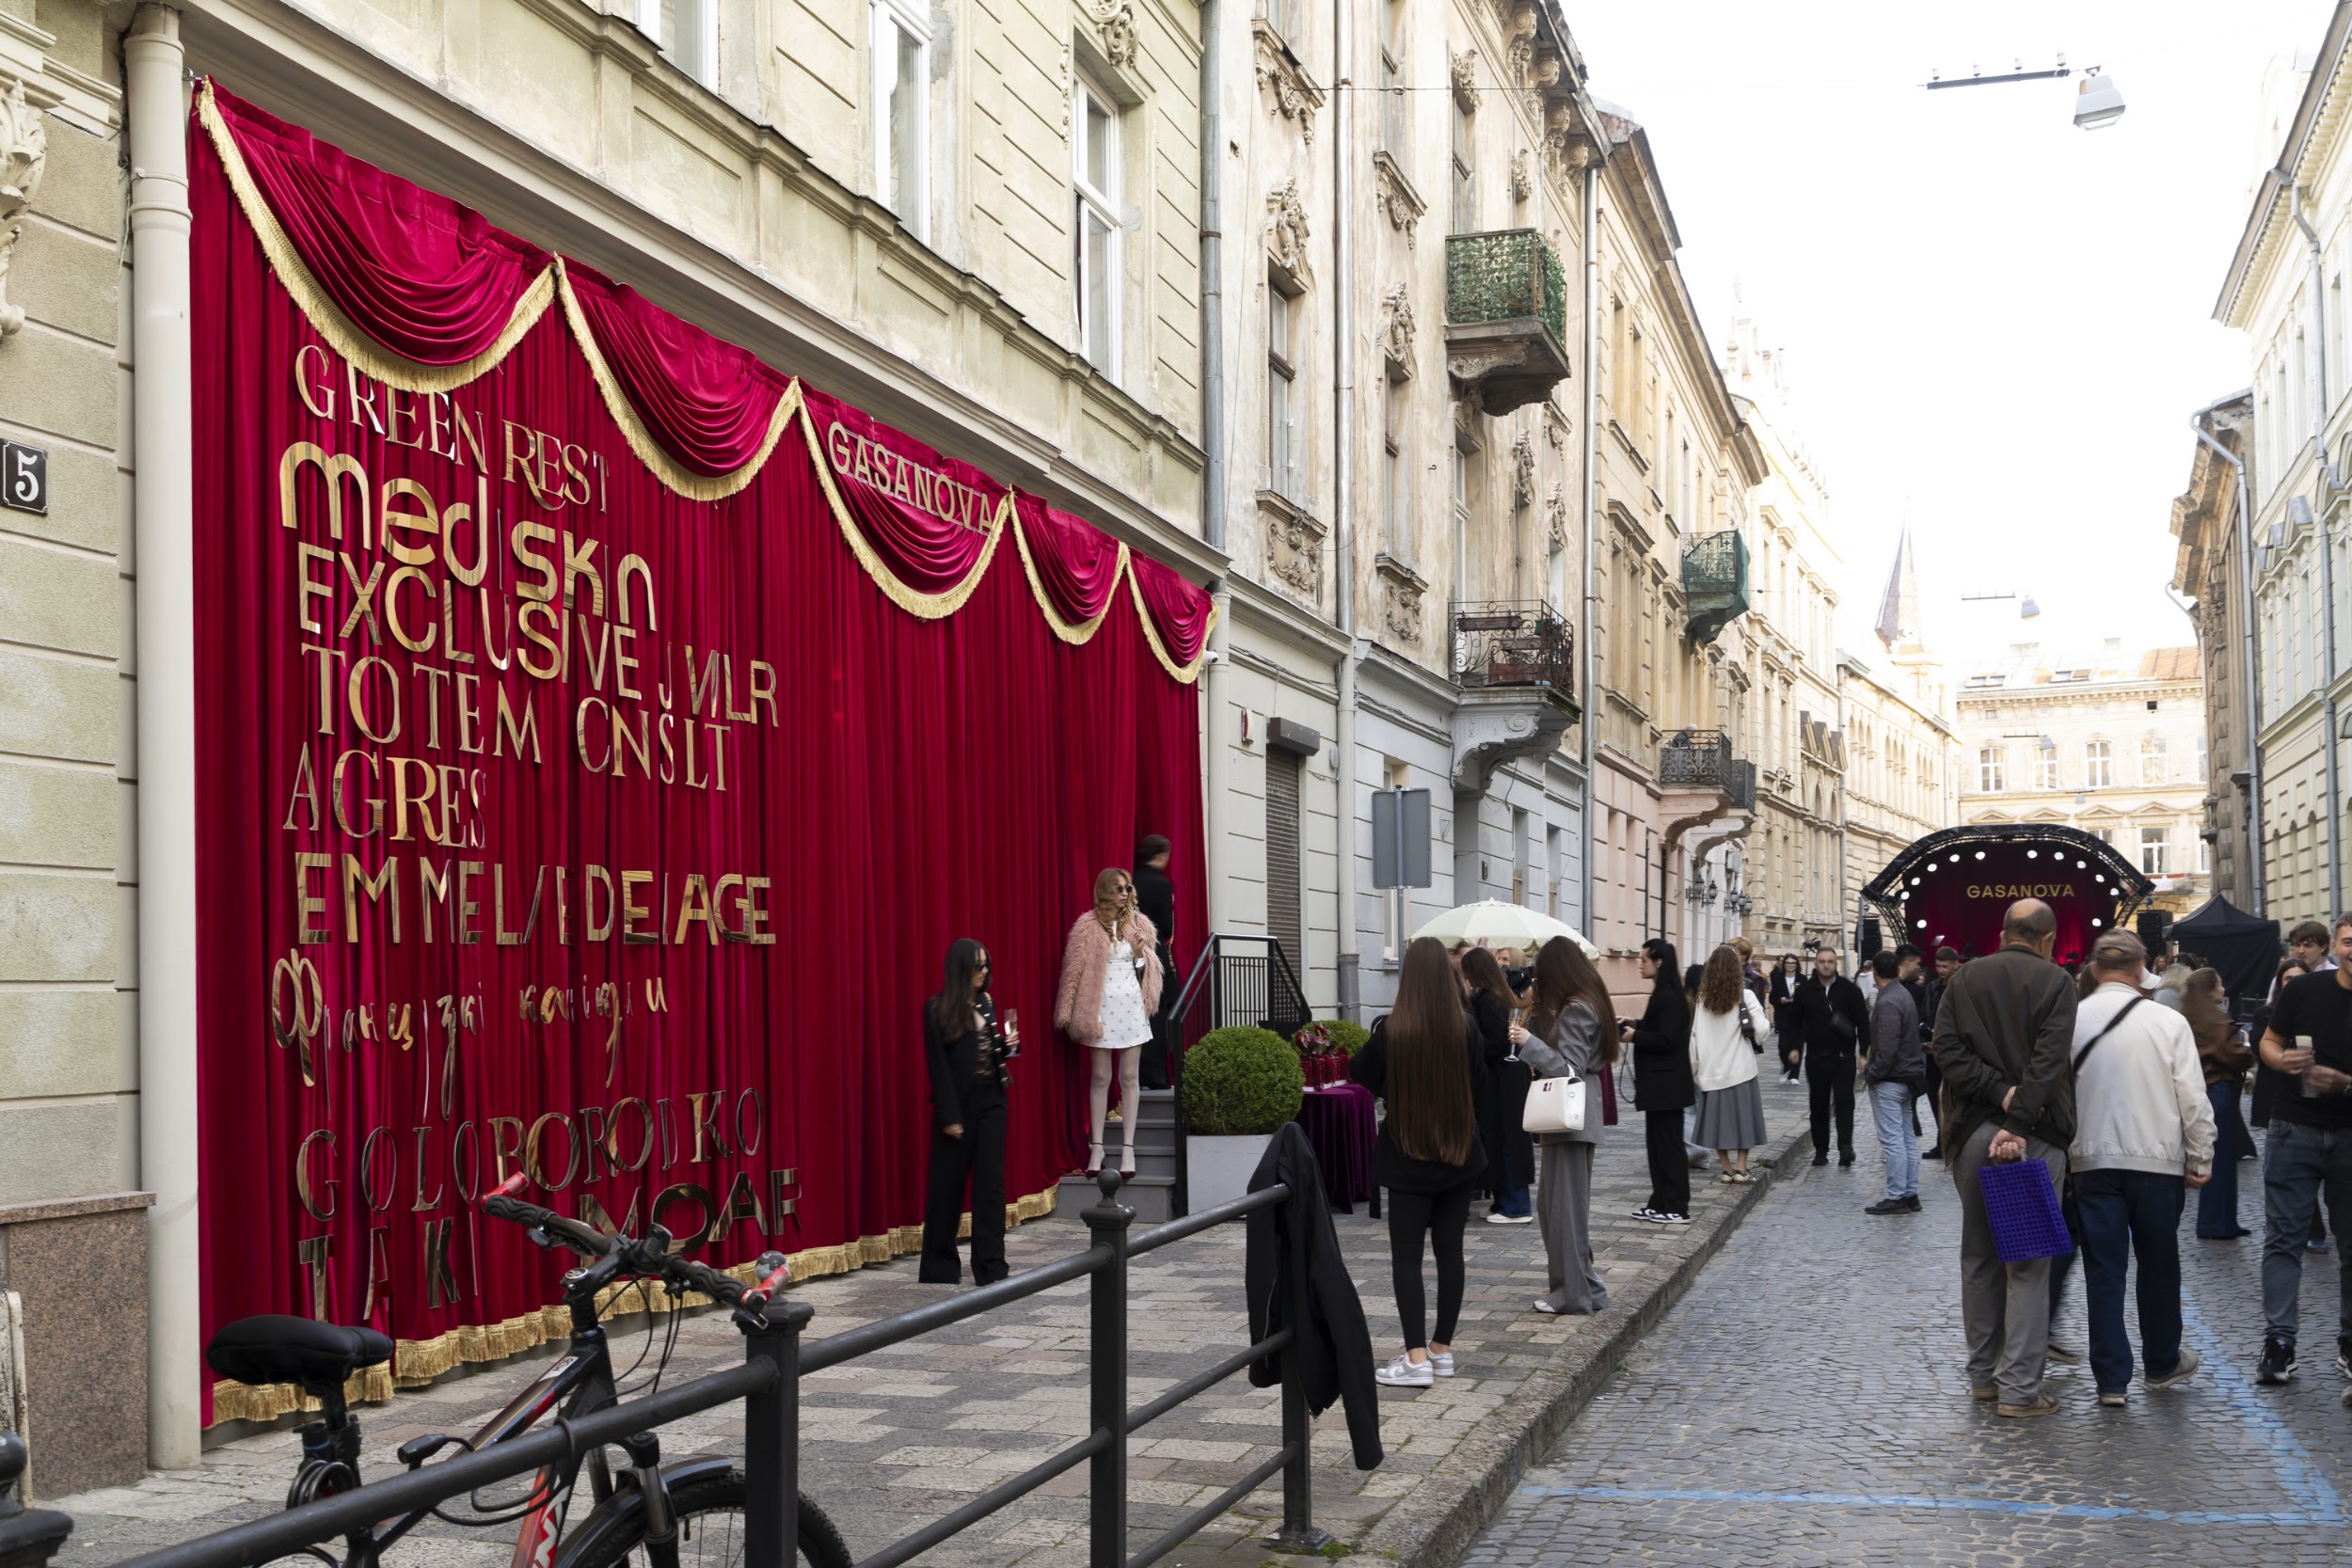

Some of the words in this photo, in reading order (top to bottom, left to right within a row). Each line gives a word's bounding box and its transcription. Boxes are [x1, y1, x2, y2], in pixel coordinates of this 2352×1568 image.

[15, 451, 40, 502] 5
[295, 345, 489, 475] GREEN
[502, 420, 610, 514] REST
[828, 421, 993, 534] GASANOVA
[298, 542, 643, 700] EXCLUSIVE
[301, 642, 543, 764] TOTEM
[577, 697, 732, 791] CNSLT
[282, 741, 486, 849] AGRES
[1966, 884, 2074, 898] GASANOVA
[296, 1088, 763, 1221] GOLOBORODKO
